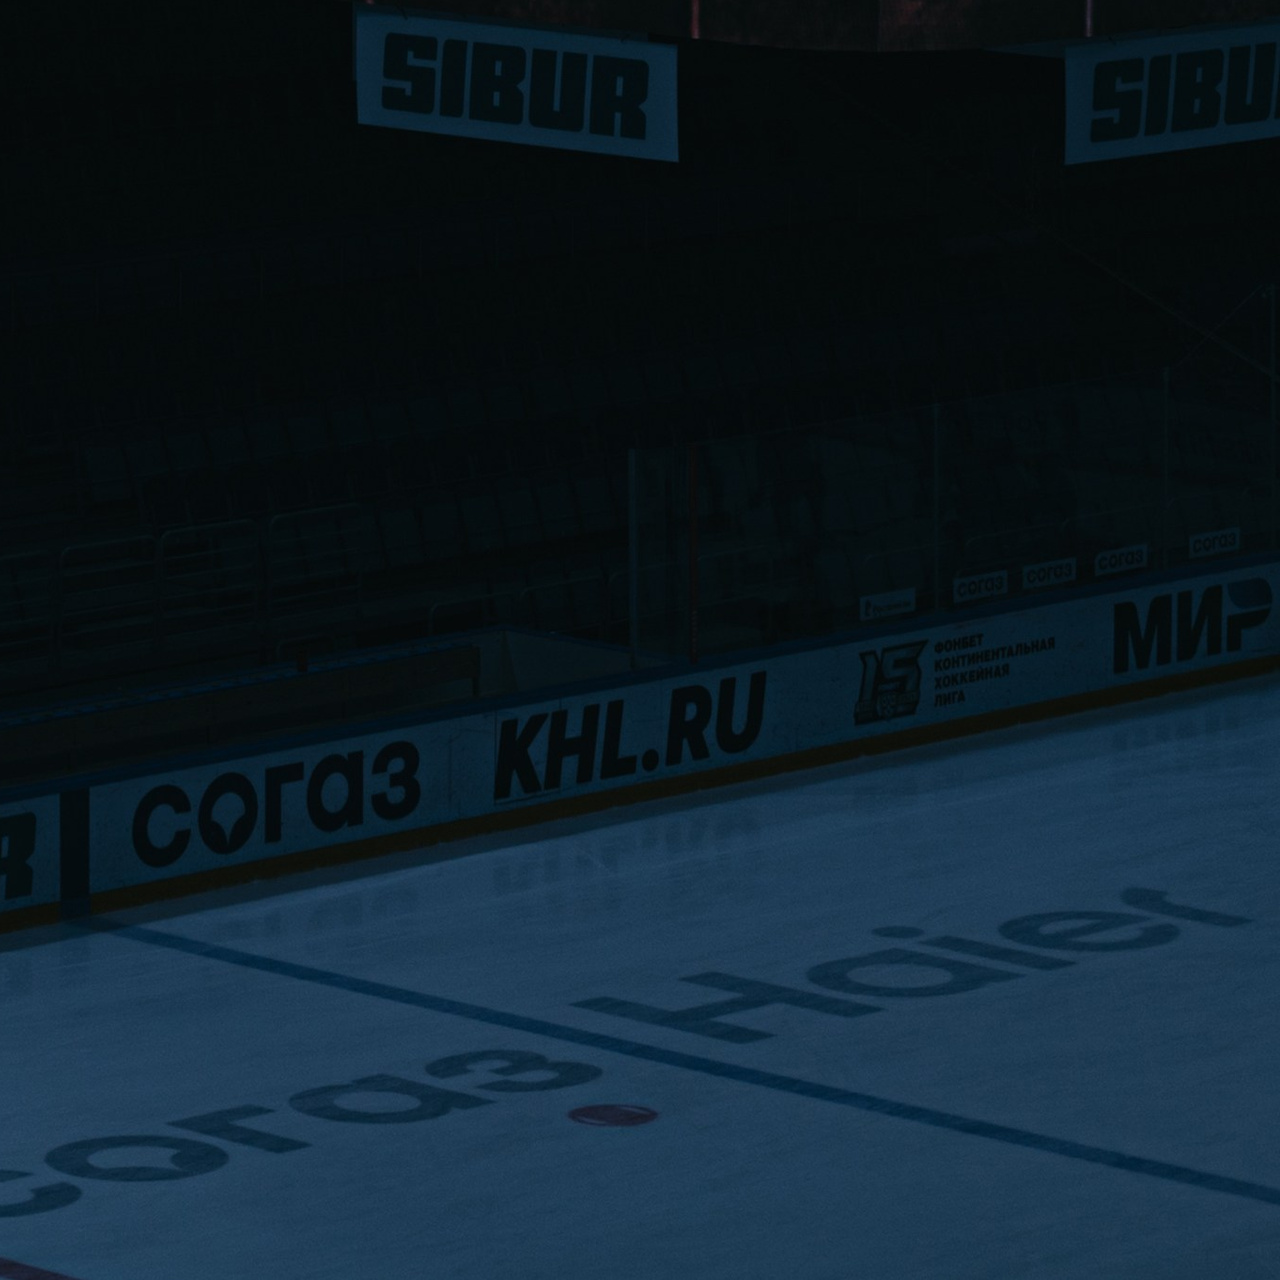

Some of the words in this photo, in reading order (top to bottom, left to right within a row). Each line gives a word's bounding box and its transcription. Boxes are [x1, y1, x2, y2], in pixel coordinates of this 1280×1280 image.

[381, 31, 650, 141] SIBUR
[934, 633, 984, 654] ФОНБЕТ
[934, 637, 1055, 672] КОНТИНЕНТАЛЬНАЯ
[1112, 577, 1273, 675] МИР
[934, 663, 1010, 690] ХОККЕЙНАЯ
[934, 690, 966, 708] ЛИГА
[494, 671, 767, 800] KHL.RU
[571, 887, 1254, 1044] Haier
